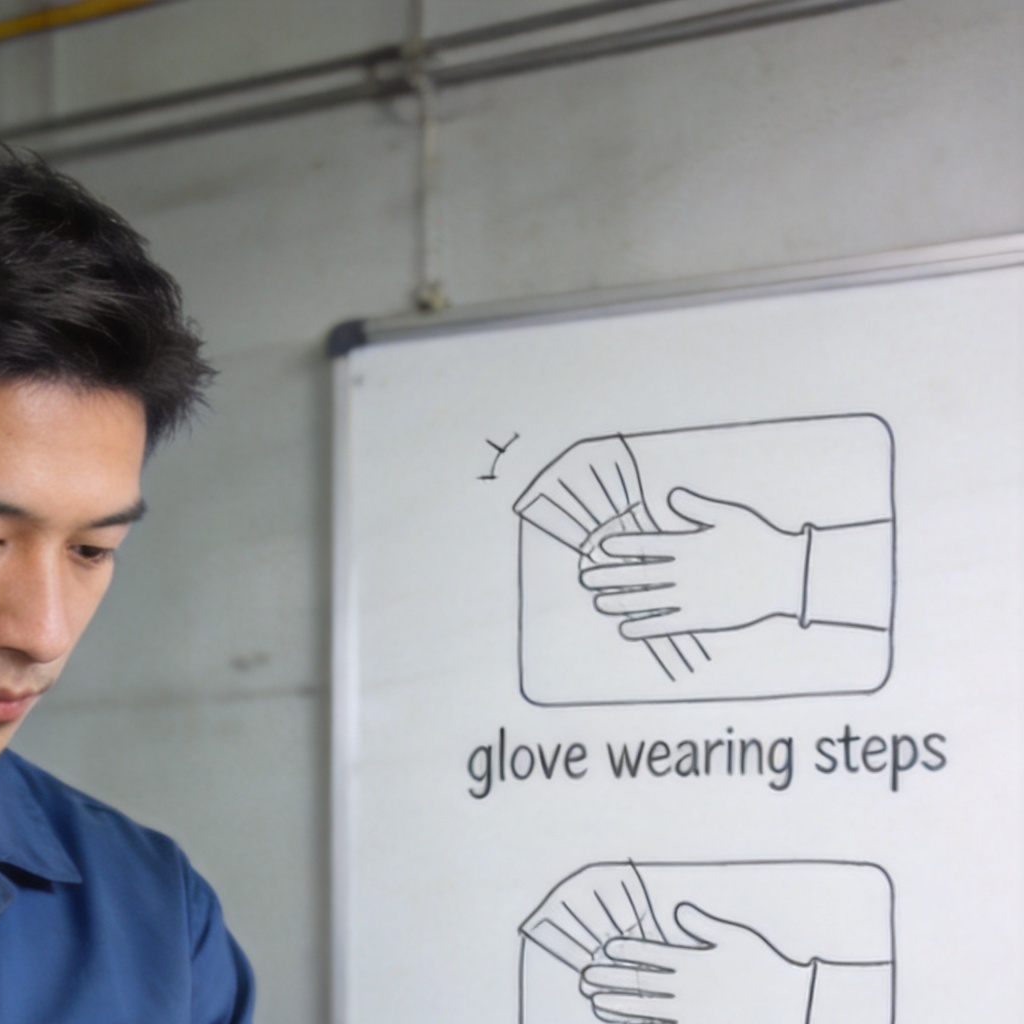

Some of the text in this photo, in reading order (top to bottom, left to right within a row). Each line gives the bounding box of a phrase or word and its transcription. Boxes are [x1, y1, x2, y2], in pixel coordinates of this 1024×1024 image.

[466, 723, 947, 800] glove wearing steps
